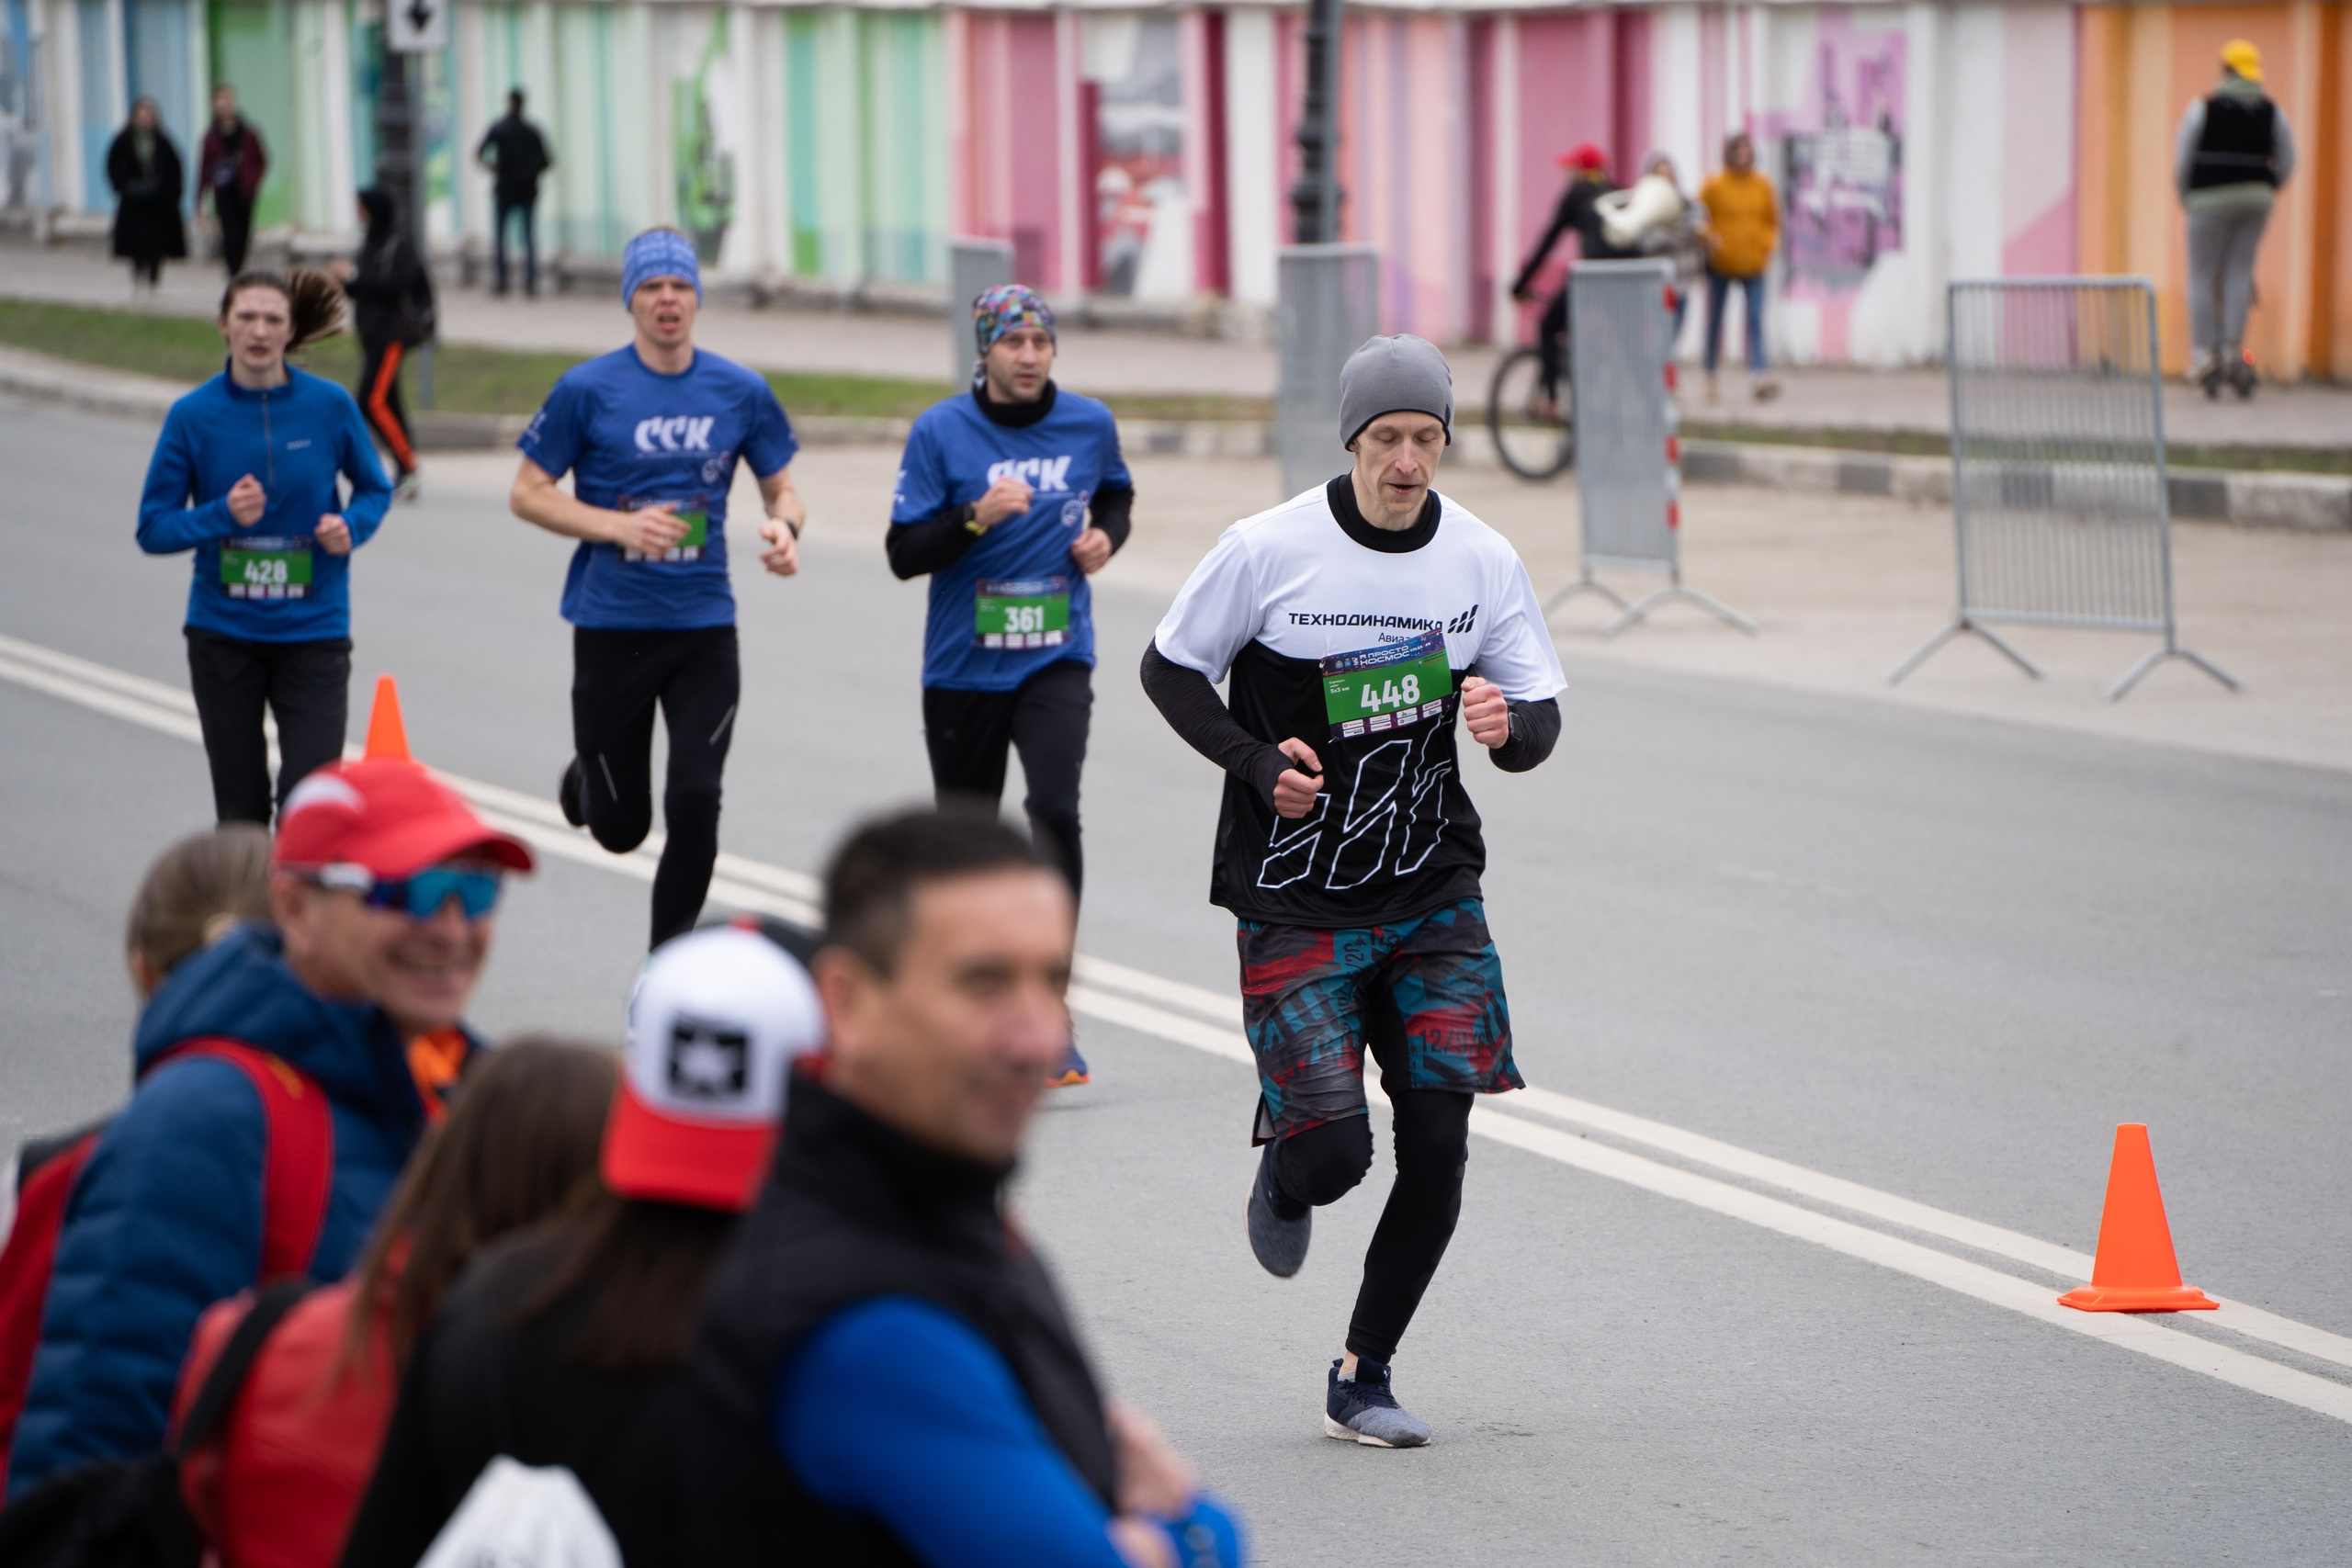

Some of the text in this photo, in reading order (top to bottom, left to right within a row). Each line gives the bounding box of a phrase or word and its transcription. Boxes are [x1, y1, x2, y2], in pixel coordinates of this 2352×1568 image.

[243, 558, 288, 584] 428
[1004, 605, 1045, 633] 361
[1288, 613, 1442, 631] ТЕХНОДИНАМИКА
[1360, 650, 1410, 666] КОСМОС
[1368, 645, 1409, 659] ПРОСТО
[1361, 674, 1420, 712] 448
